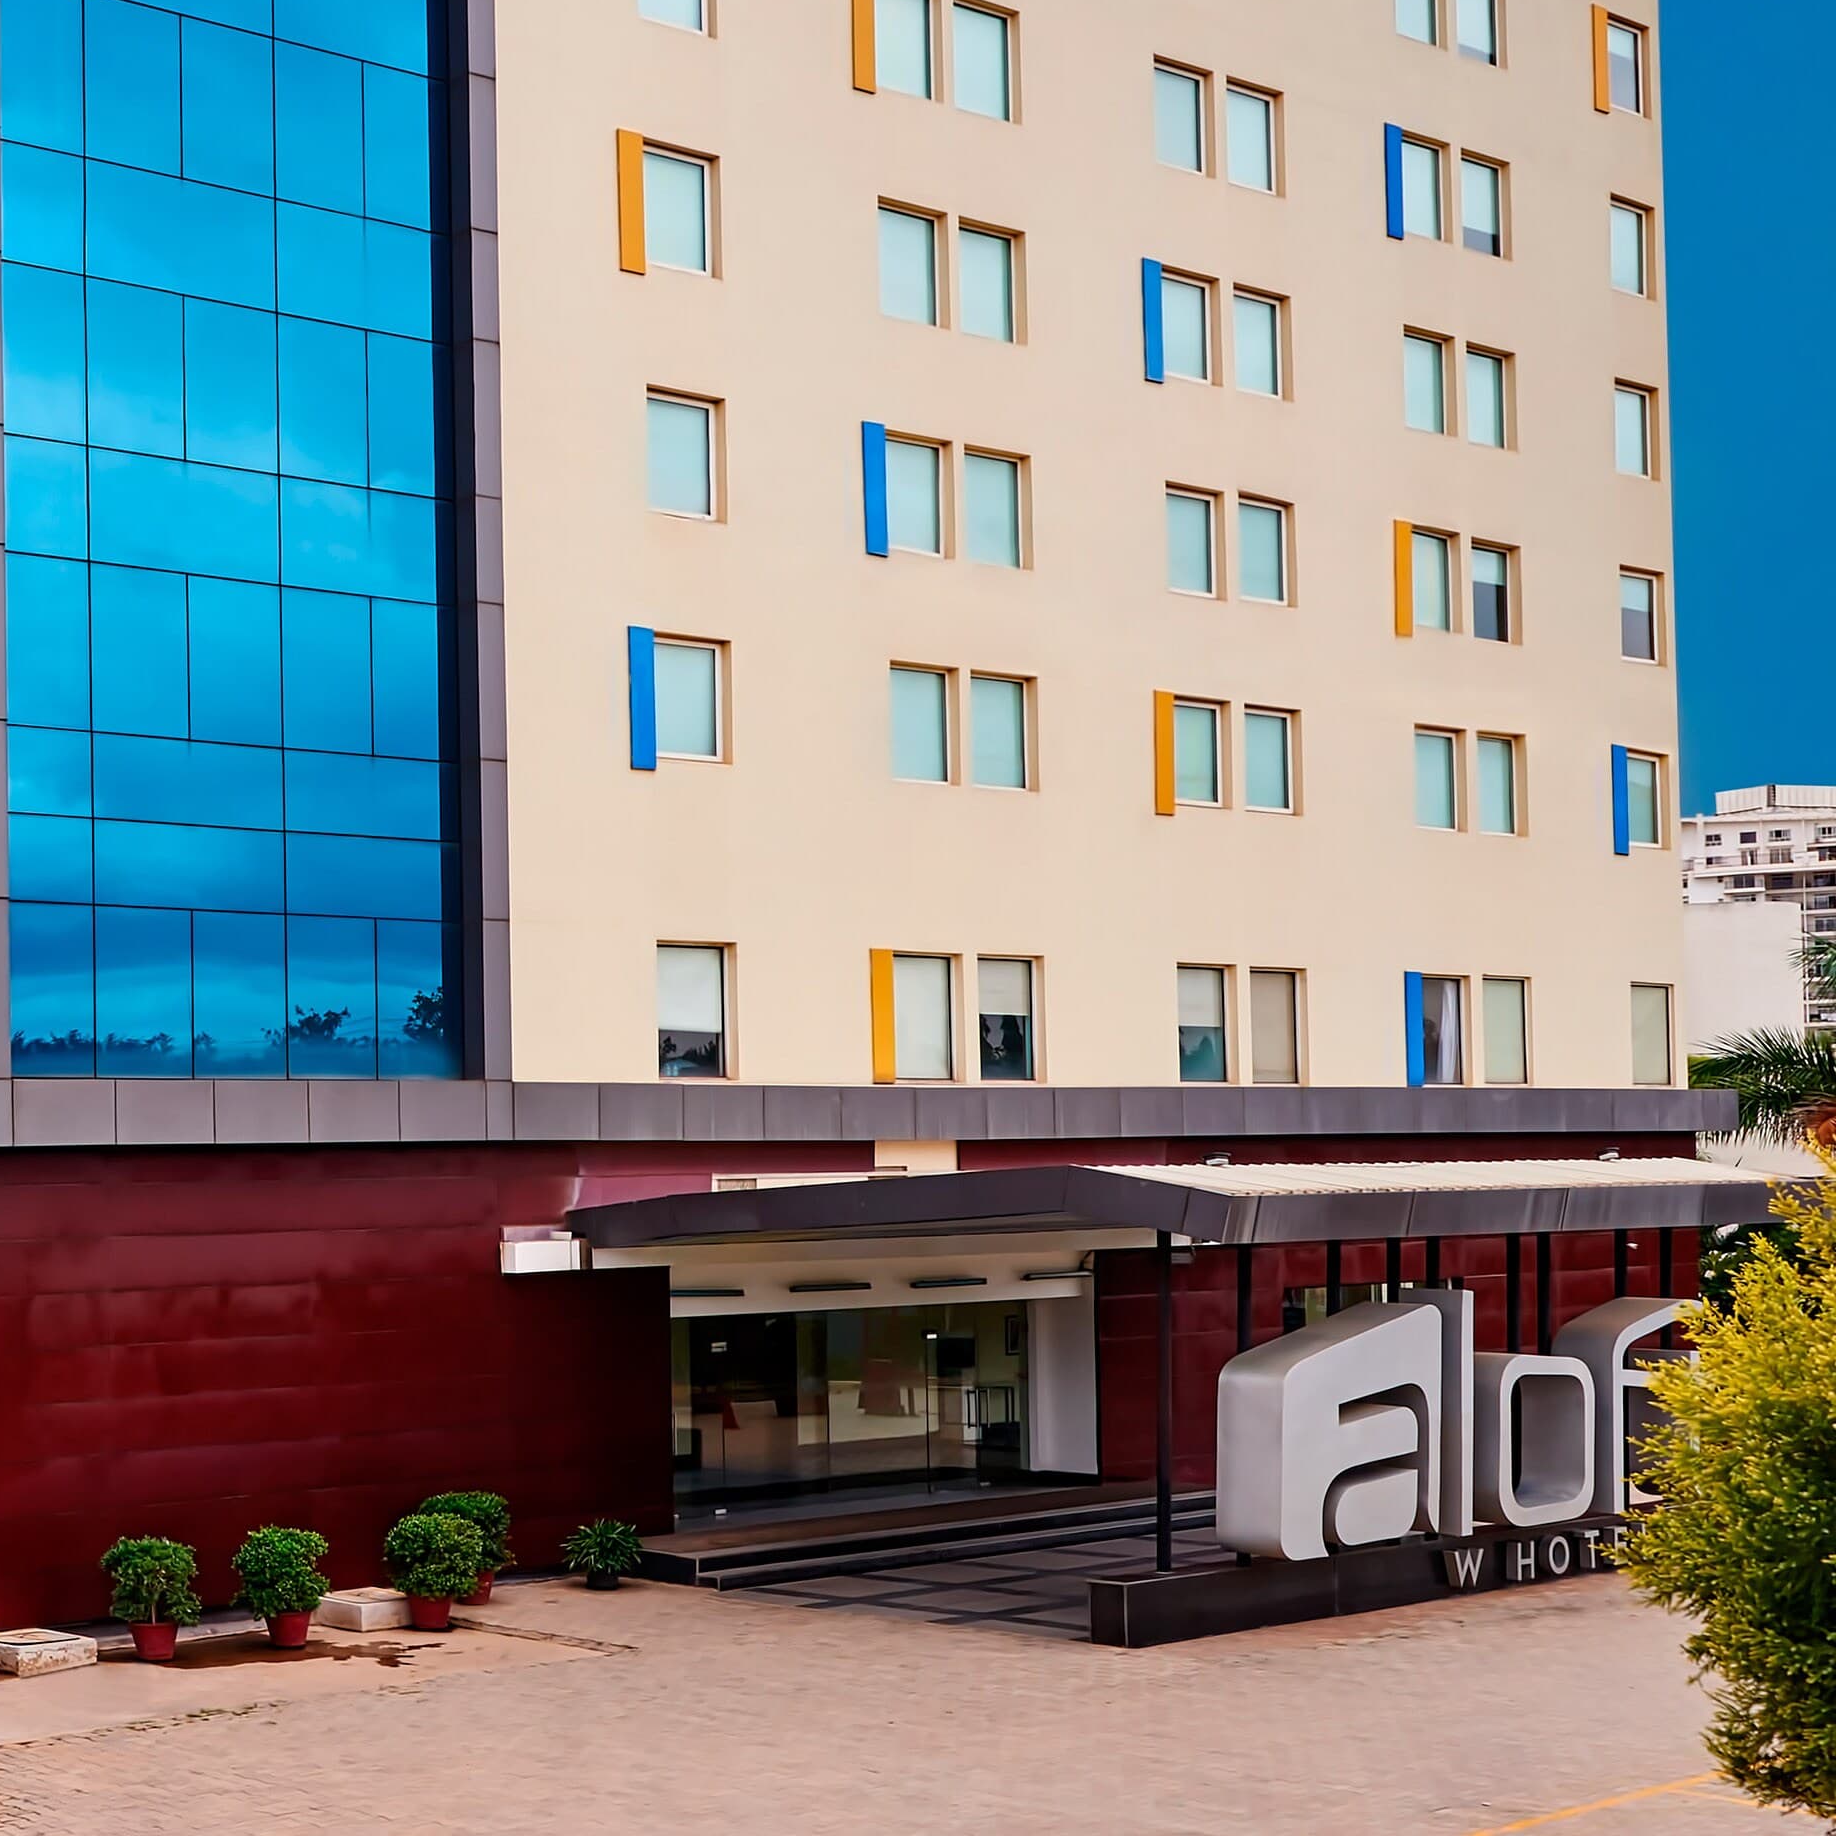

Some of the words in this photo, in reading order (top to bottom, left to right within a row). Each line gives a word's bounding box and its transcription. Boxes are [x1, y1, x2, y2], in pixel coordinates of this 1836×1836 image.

[1216, 1289, 1705, 1562] alof
[1445, 1548, 1485, 1589] W
[1506, 1523, 1647, 1582] HOTE
